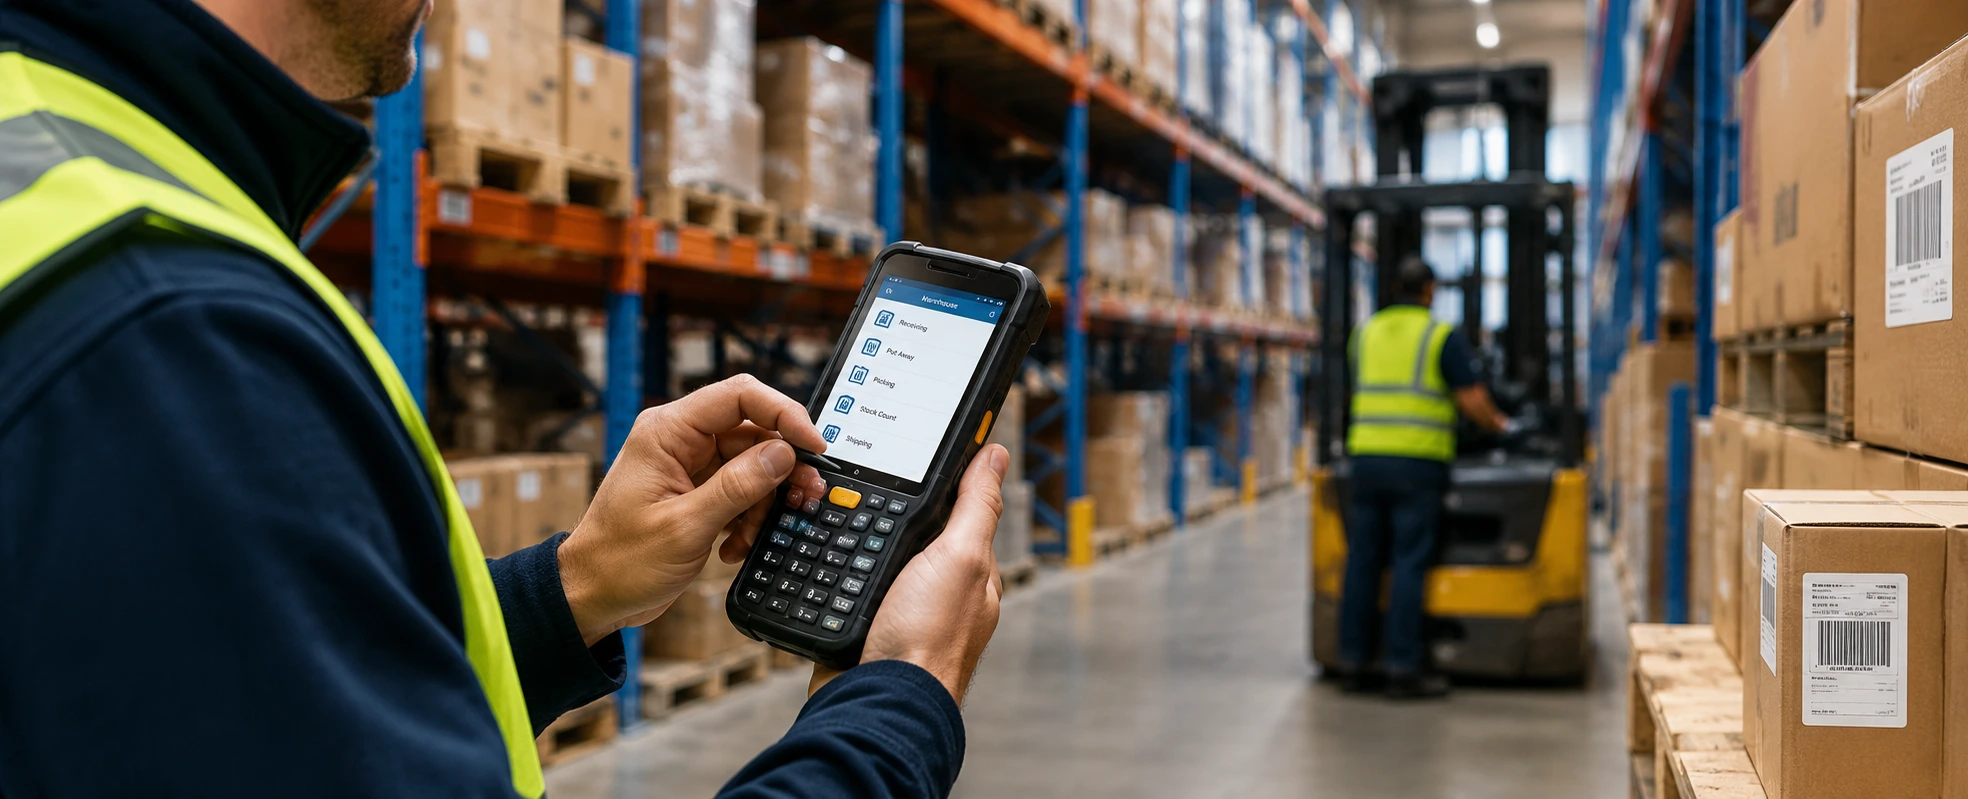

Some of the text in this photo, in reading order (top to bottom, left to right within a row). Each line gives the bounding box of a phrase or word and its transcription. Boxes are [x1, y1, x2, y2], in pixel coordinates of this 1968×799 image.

[898, 319, 928, 333] Receiving
[886, 347, 915, 362] Put Away
[873, 376, 896, 389] Picking
[878, 410, 897, 422] Count
[845, 434, 873, 450] Shipping
